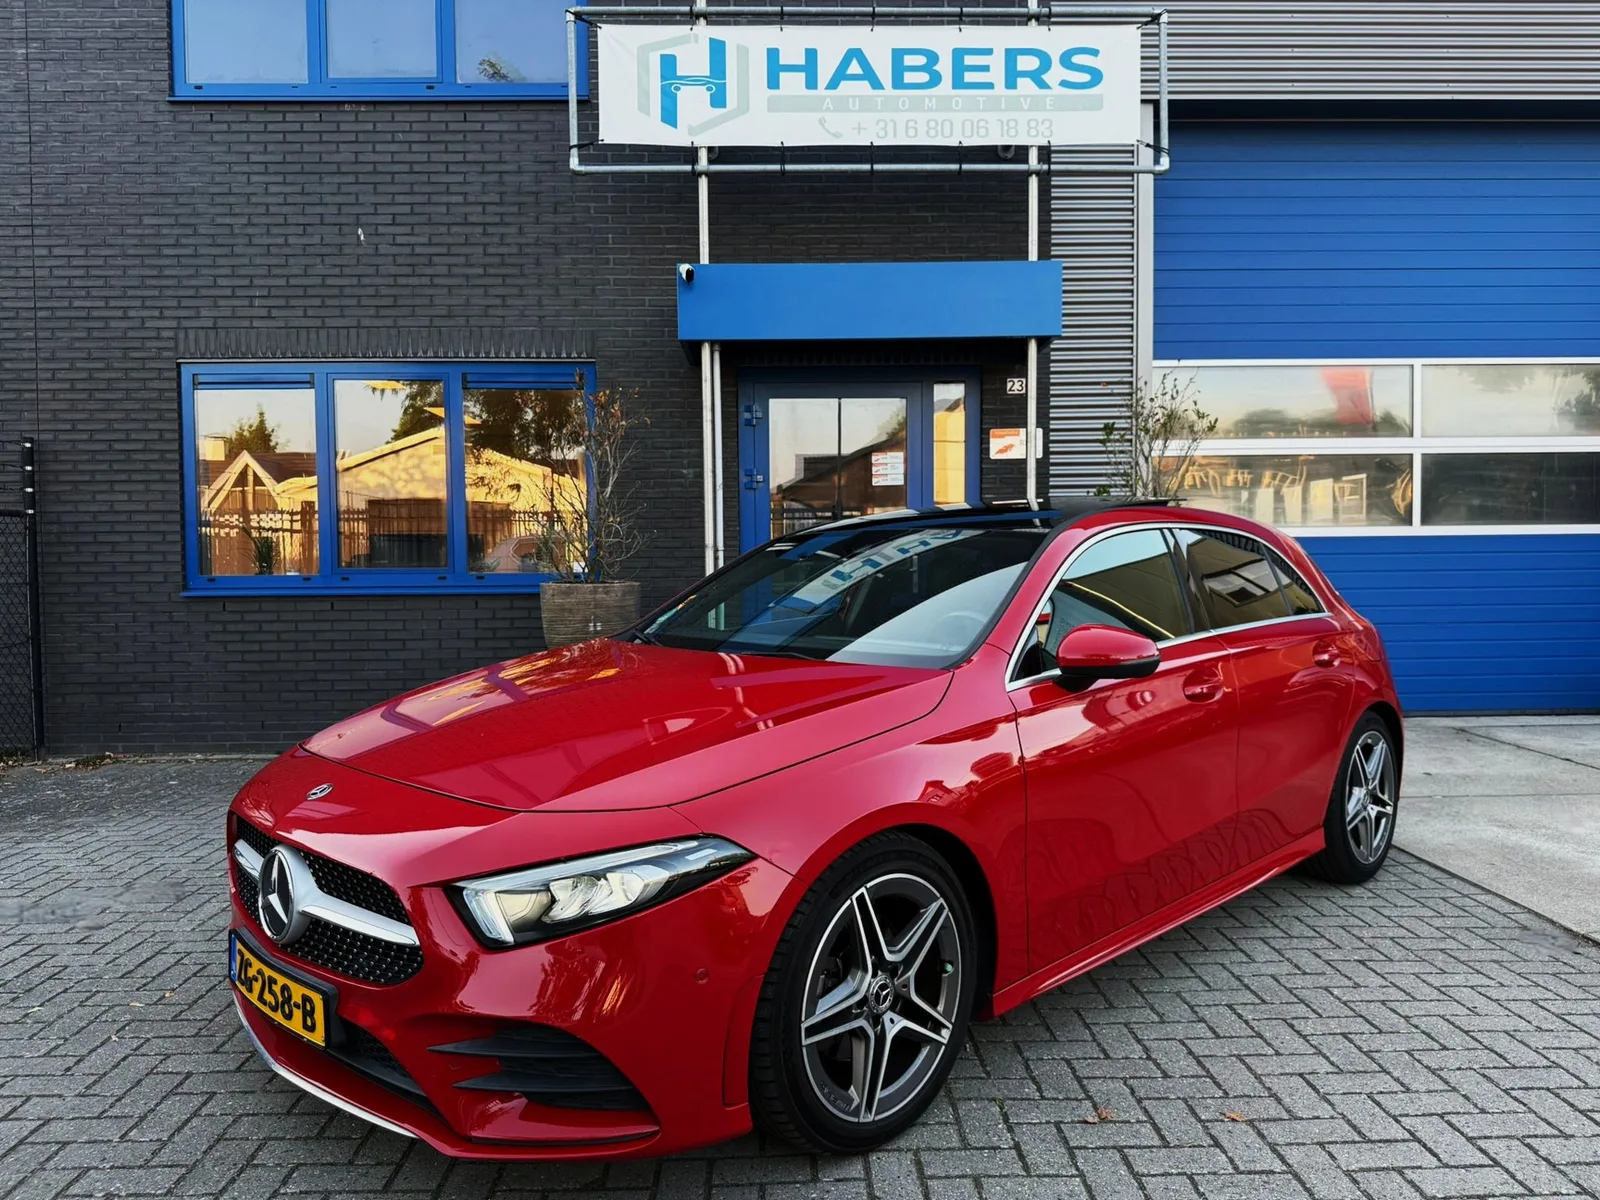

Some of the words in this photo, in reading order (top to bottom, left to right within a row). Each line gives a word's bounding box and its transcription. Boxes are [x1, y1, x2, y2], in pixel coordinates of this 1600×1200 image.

[766, 46, 1104, 91] HABERS
[822, 97, 1056, 111] AUTOMOTIVE
[904, 118, 919, 139] 6
[925, 118, 954, 139] 80
[961, 118, 990, 139] 06
[997, 118, 1020, 139] 18
[1026, 118, 1054, 139] 83
[1008, 380, 1024, 392] 23
[237, 949, 317, 1033] ZG-258-B
